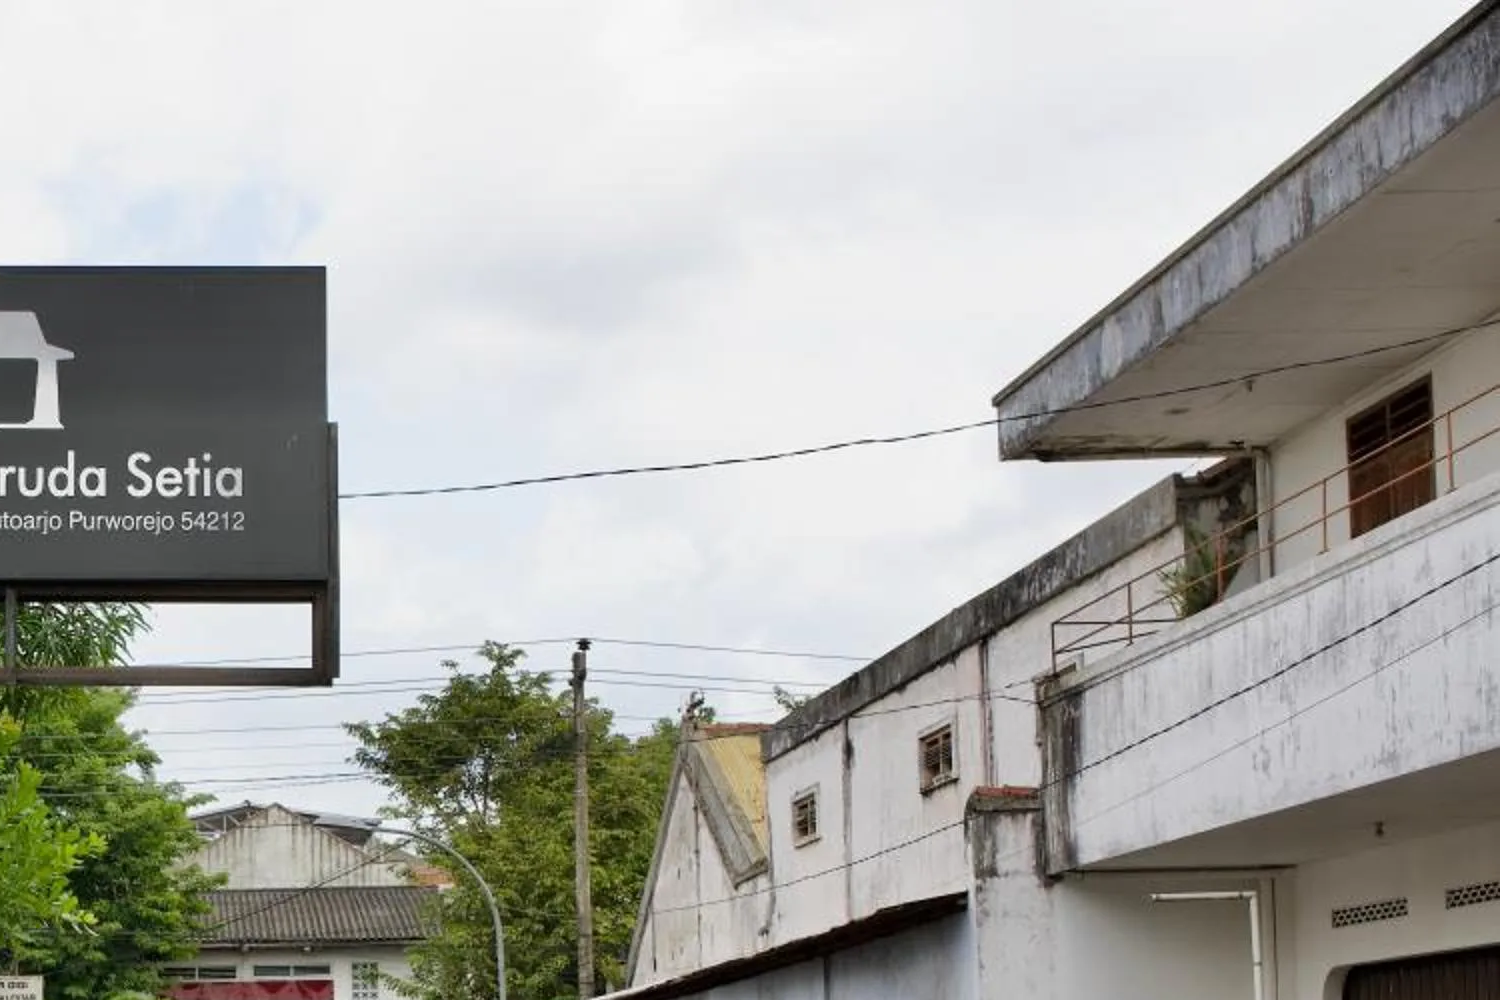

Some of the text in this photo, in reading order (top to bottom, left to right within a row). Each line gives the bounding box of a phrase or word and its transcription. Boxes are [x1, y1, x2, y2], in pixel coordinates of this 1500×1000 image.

[126, 451, 244, 498] Setia
[69, 510, 175, 536] Purworejo
[181, 511, 245, 531] 54212
